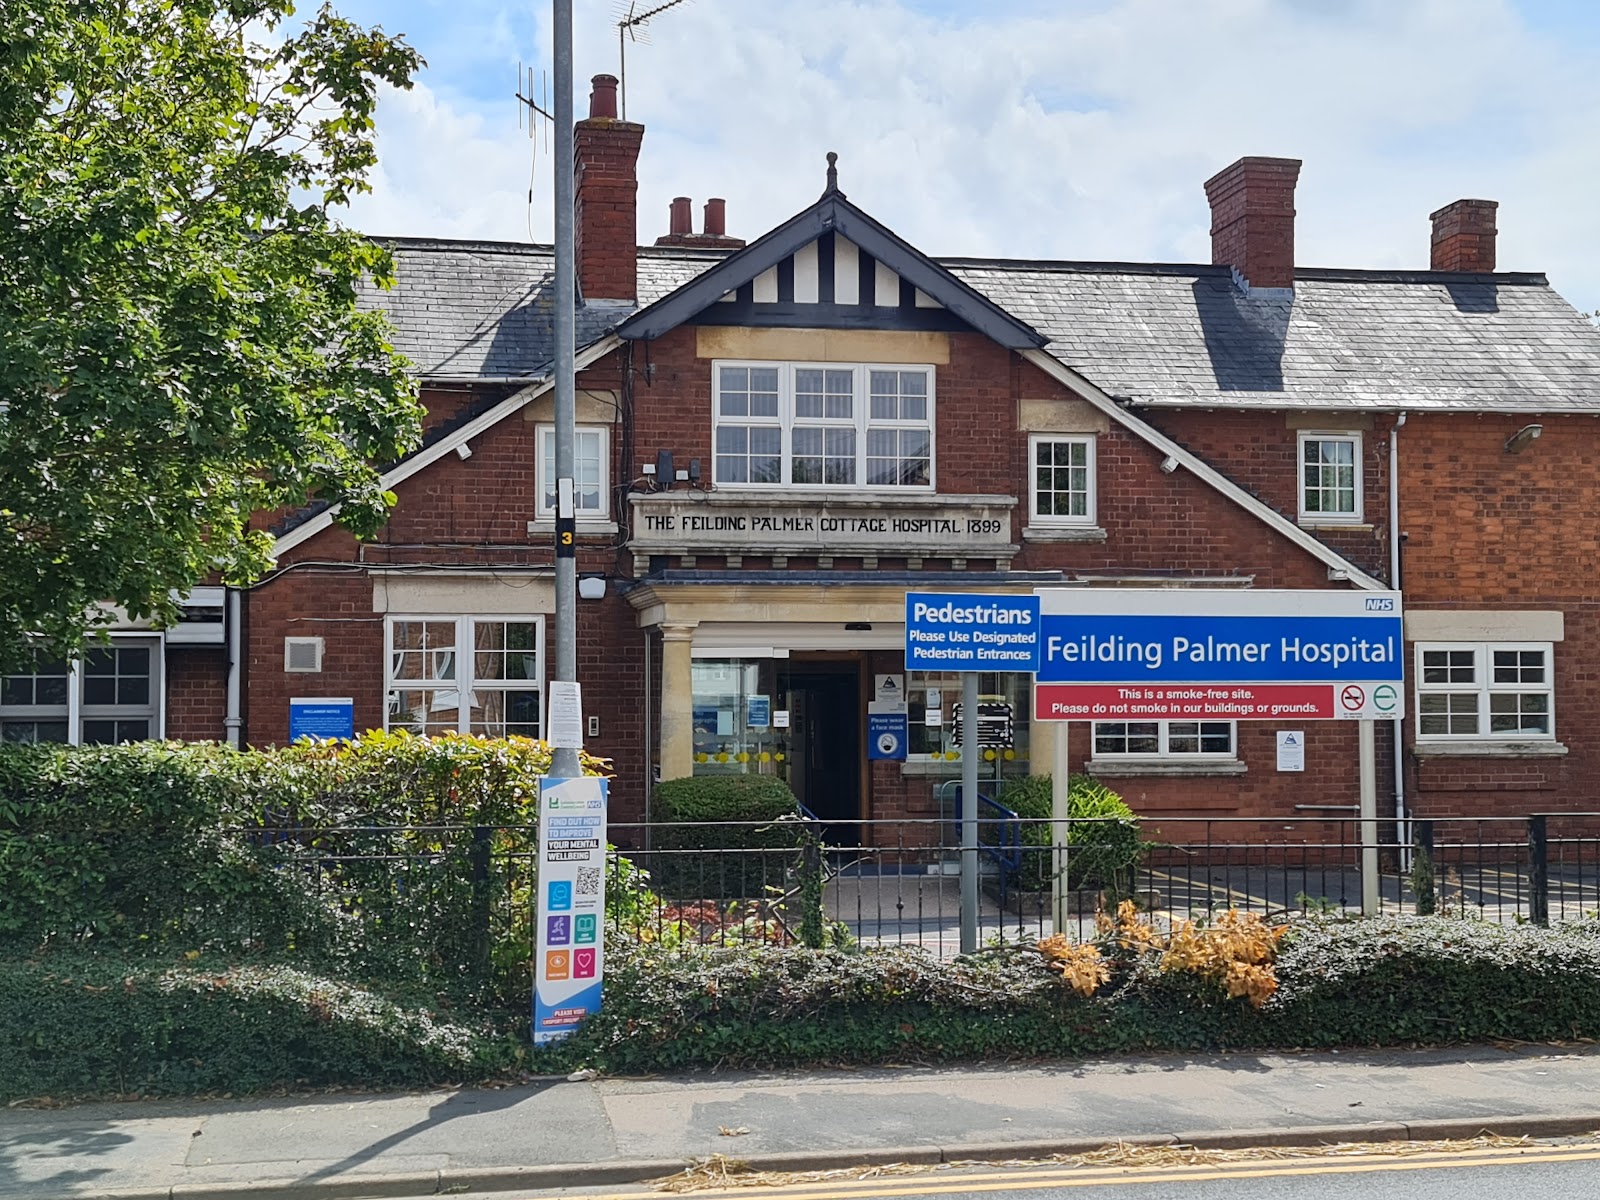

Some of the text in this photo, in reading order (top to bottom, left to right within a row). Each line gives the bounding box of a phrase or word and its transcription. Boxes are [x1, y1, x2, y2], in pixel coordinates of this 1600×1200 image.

[645, 516, 1001, 533] THE FEILDING PALMER COTTAGE HOSPITAL 1899
[561, 531, 573, 545] 3
[1366, 599, 1393, 611] NHS
[914, 602, 1032, 625] Pedestrians
[909, 630, 1036, 646] Please Use Designated
[914, 646, 1031, 660] Pedestrian Entrances
[1047, 634, 1394, 669] Feilding Palmer Hospital
[1118, 688, 1255, 699] This is a smoke-free site.
[1052, 703, 1319, 716] Please do not smoke in our buildings or grounds.
[549, 817, 600, 826] FIND OUT HOW
[548, 829, 592, 838] TO IMPROVE
[548, 839, 598, 849] YOUR MENTAL
[548, 852, 589, 861] WELLBEING
